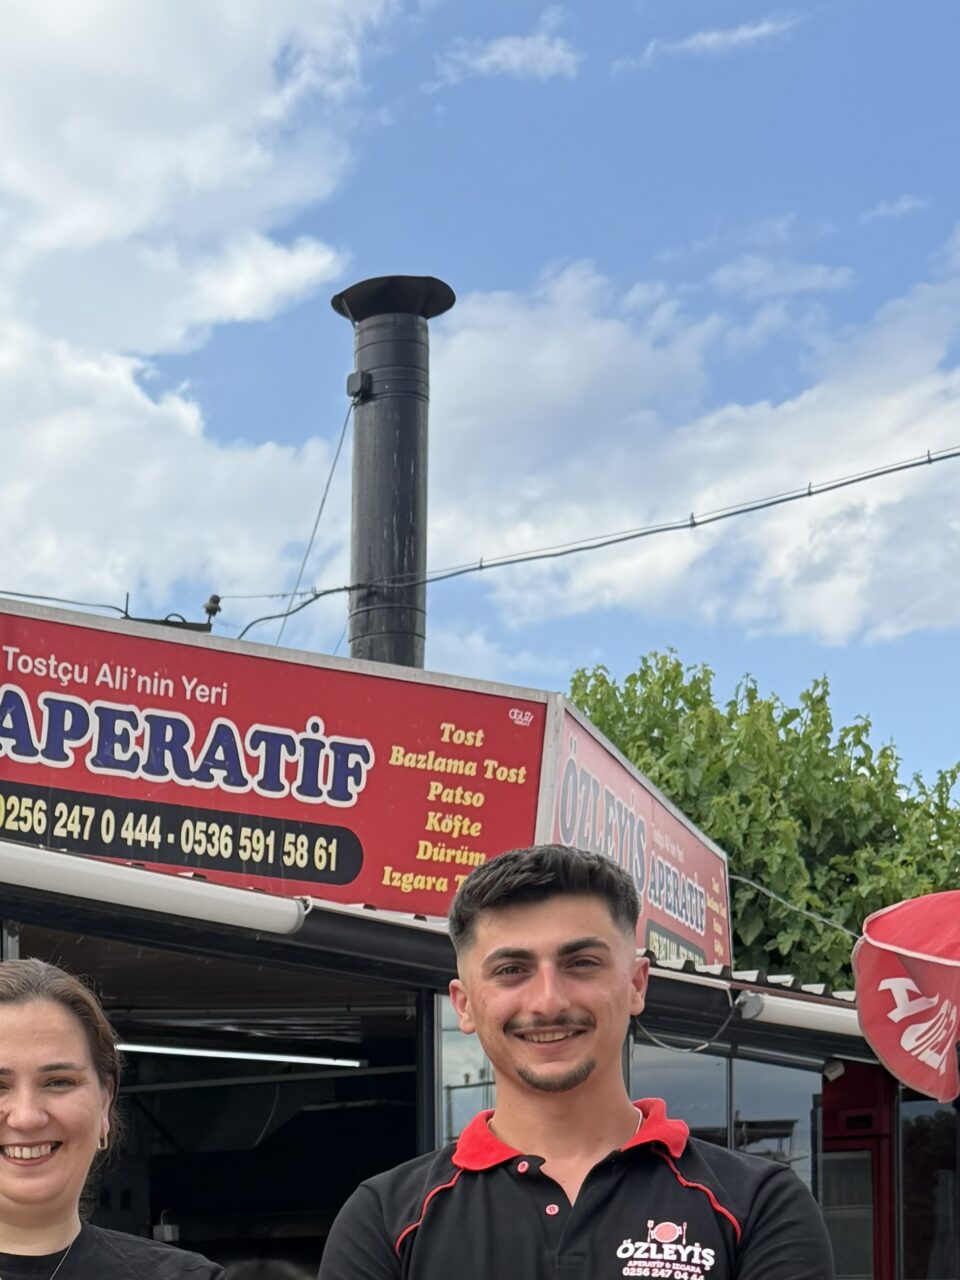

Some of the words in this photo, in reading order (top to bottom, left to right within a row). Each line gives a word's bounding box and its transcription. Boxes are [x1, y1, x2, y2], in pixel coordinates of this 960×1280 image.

[2, 646, 89, 687] Tostçu
[181, 675, 228, 706] Yeri
[440, 722, 485, 747] Tost
[389, 745, 478, 777] Bazlama
[483, 759, 527, 784] Tost
[427, 781, 485, 808] Patso
[53, 802, 96, 841] 247
[100, 808, 115, 844] 0
[120, 812, 161, 849] 444
[180, 819, 233, 859] 0536
[238, 827, 276, 864] 591
[283, 832, 309, 868] 58
[314, 836, 338, 872] 61
[425, 811, 482, 838] Köfte
[416, 840, 487, 867] Dürüm
[382, 866, 449, 893] Izgara
[616, 1239, 715, 1271] ÖZLEYİŞ
[622, 1267, 650, 1276] 0256
[651, 1269, 672, 1278] 247
[674, 1270, 689, 1280] 04
